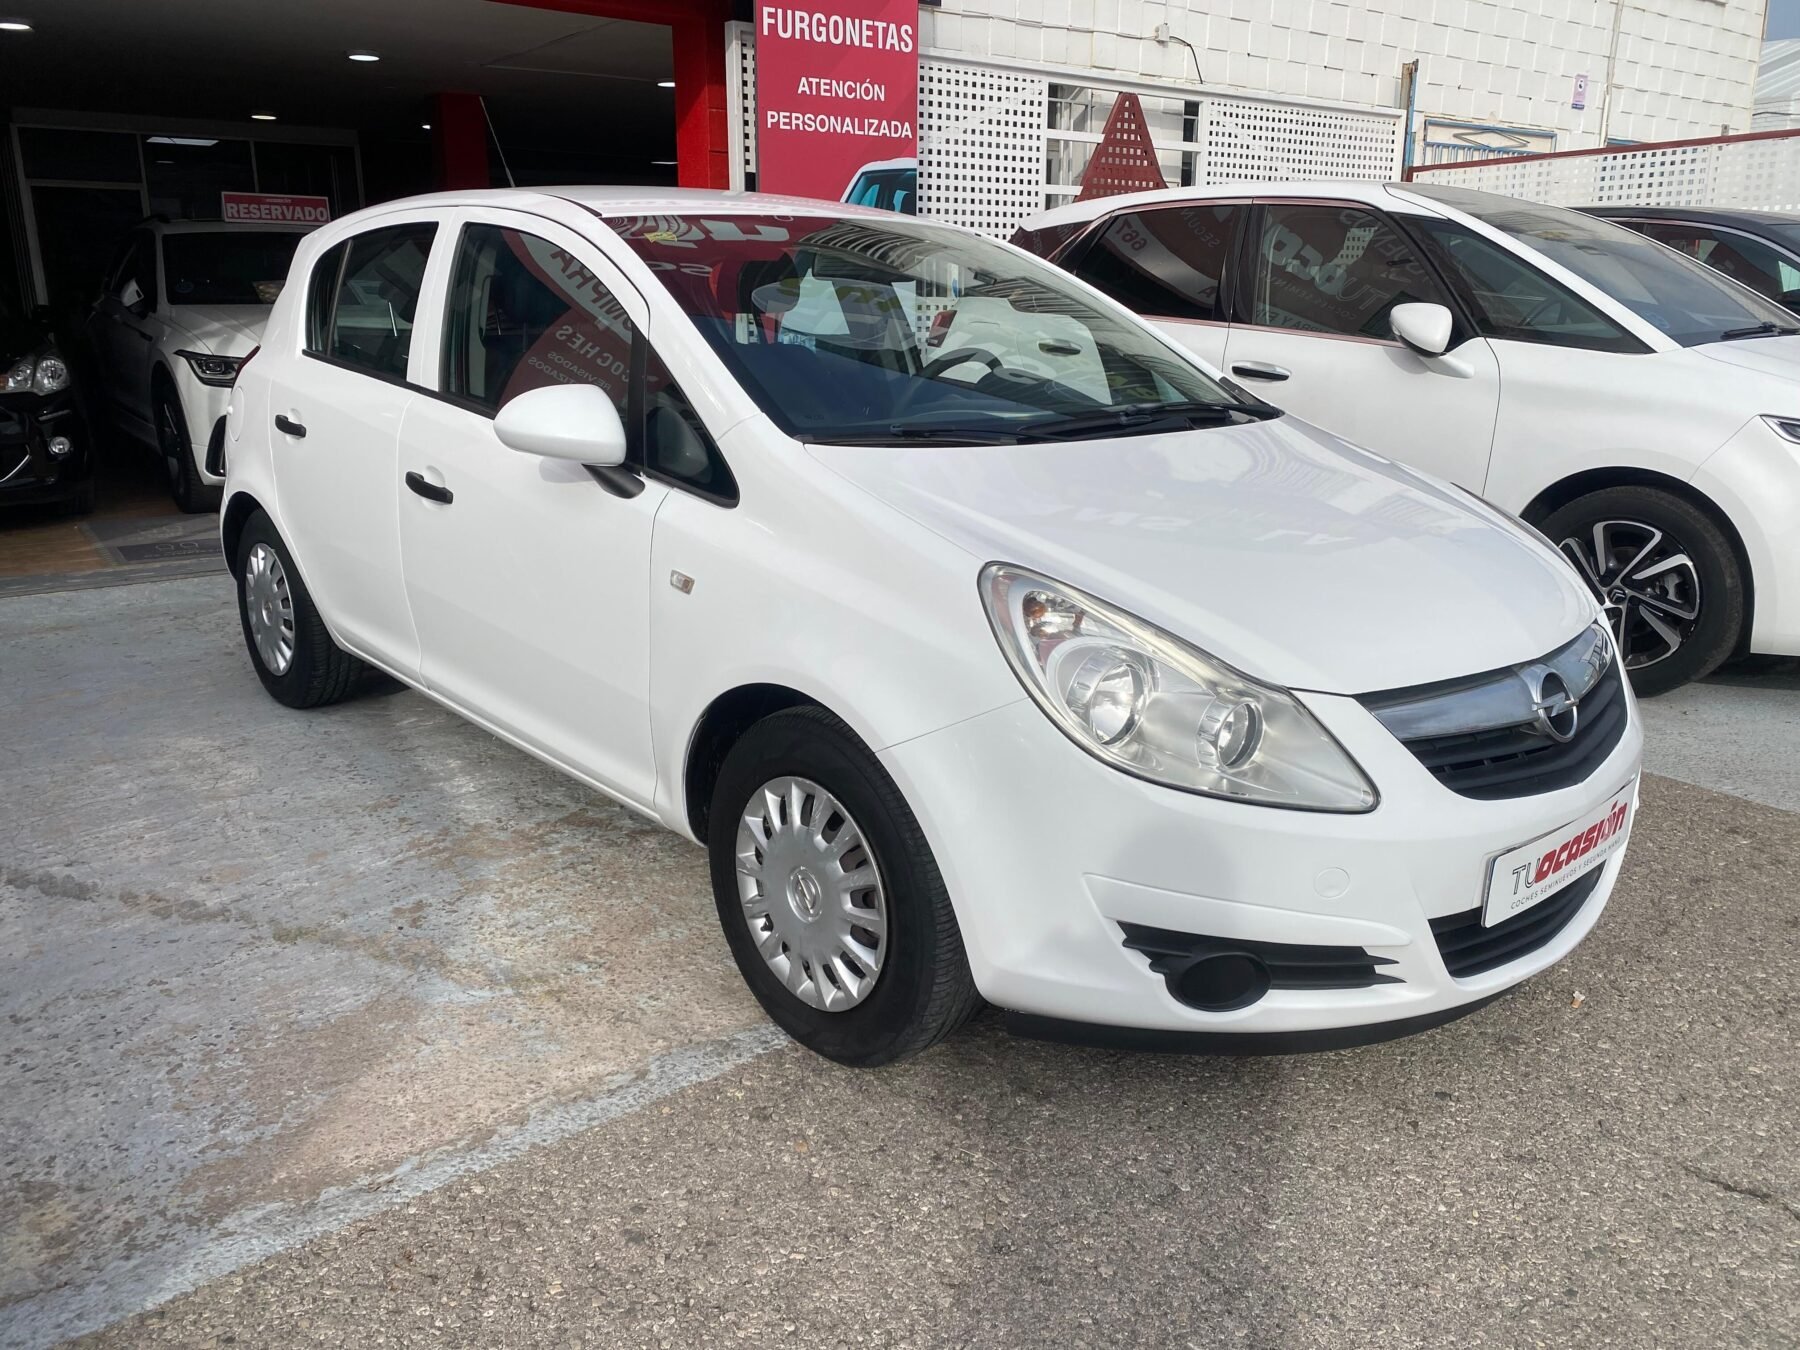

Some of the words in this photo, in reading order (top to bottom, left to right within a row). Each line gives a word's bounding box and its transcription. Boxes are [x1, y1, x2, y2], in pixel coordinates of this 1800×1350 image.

[762, 6, 914, 54] FURGONETAS
[797, 76, 886, 102] ATENCIÓN
[766, 110, 913, 139] PERSONALIZADA
[226, 202, 328, 221] RESERVADO
[1510, 890, 1539, 910] COCHES
[1540, 867, 1578, 895] SEMINUEVOS
[1583, 848, 1607, 868] SEGUNDA
